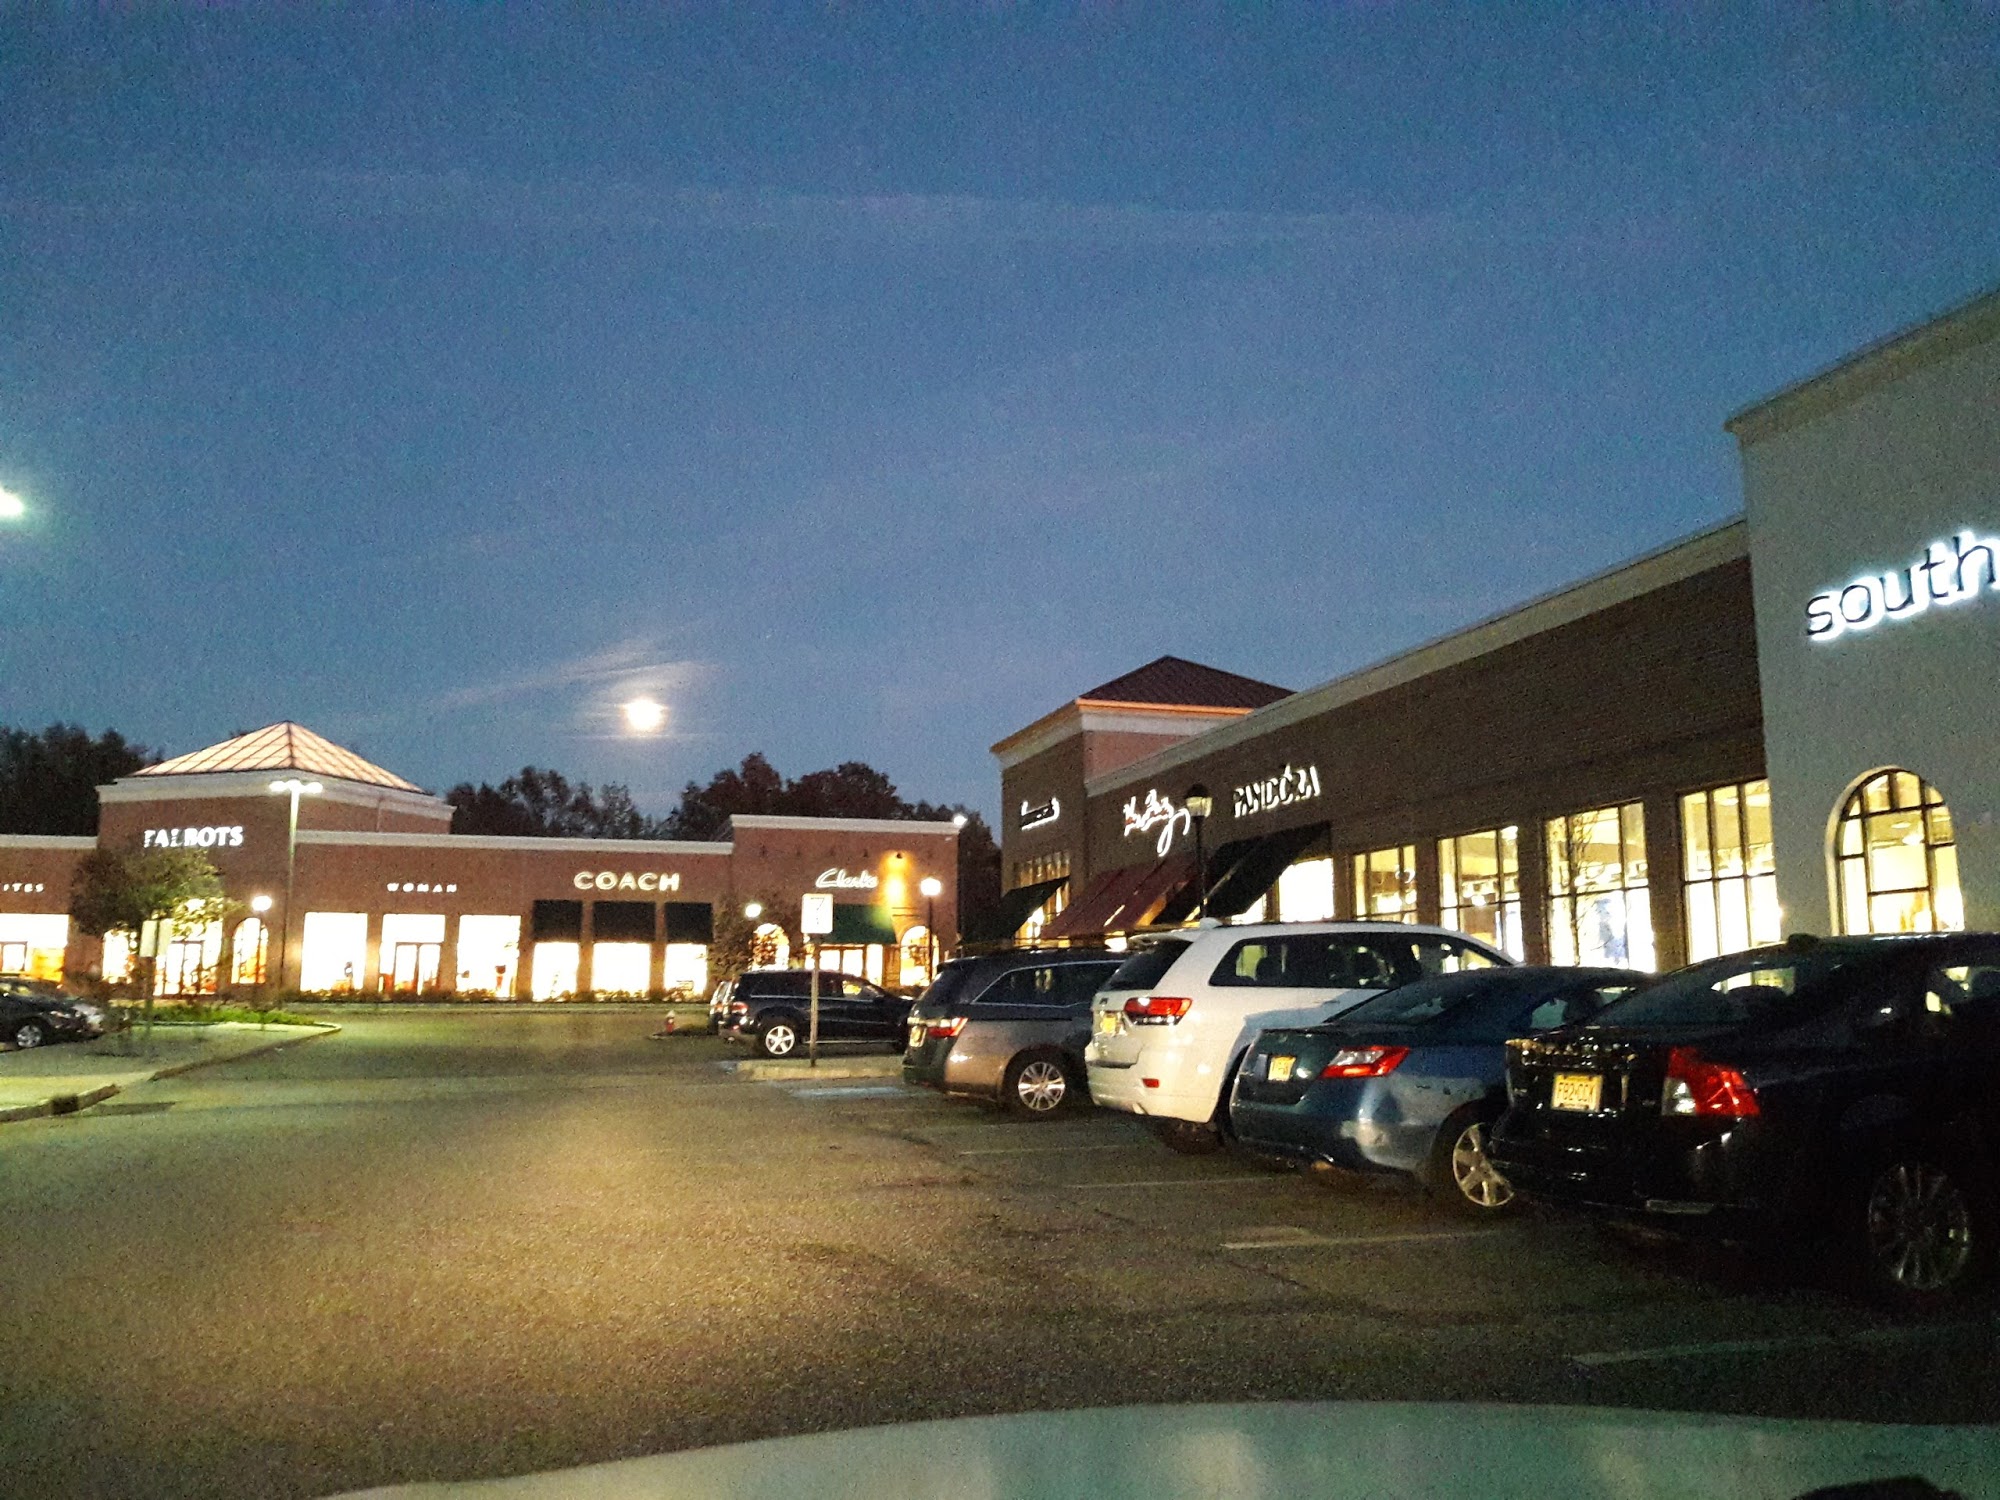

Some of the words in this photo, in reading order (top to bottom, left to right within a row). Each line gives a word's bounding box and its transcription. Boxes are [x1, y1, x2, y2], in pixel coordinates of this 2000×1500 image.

[1805, 530, 1999, 641] south
[143, 826, 244, 848] TALBOTS
[573, 870, 680, 892] COACH
